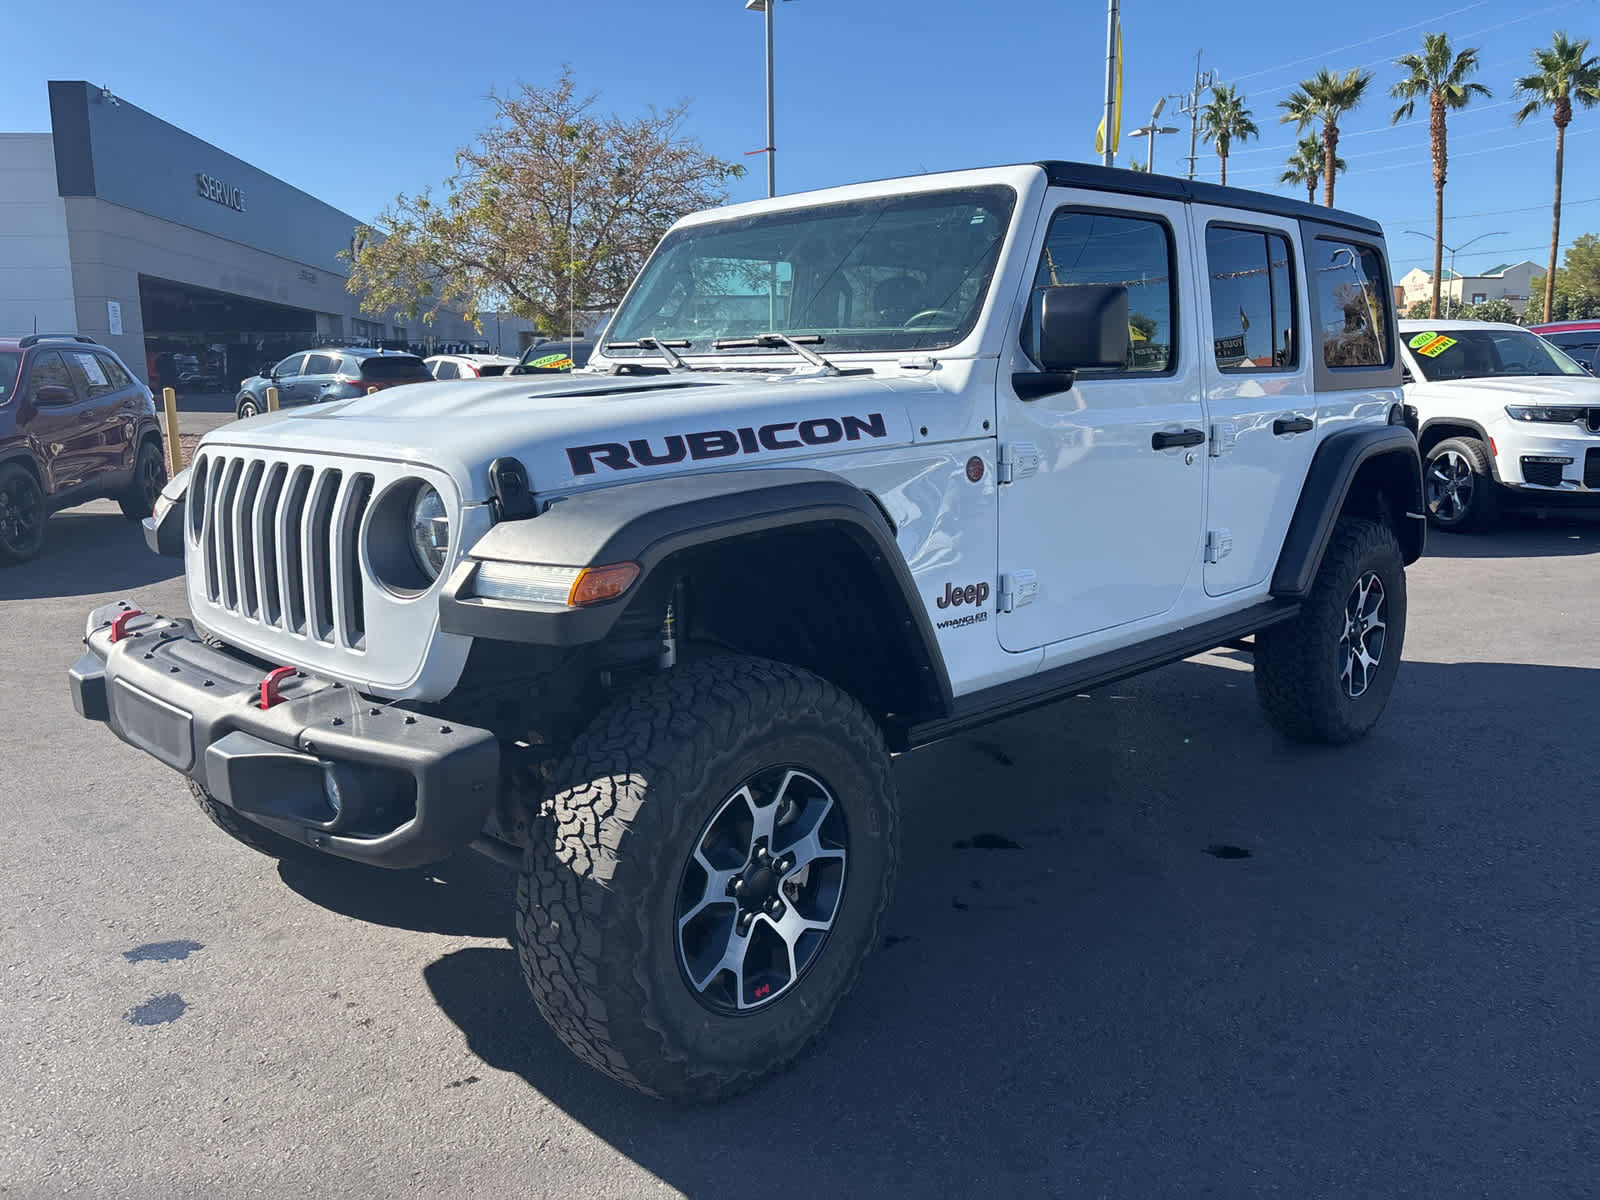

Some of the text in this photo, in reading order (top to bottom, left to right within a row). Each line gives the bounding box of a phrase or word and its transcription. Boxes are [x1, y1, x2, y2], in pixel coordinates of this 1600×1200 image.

[200, 173, 247, 212] SERVICE
[566, 413, 887, 476] RUBICON
[936, 582, 990, 609] Jeep
[936, 612, 988, 629] WRANGLER
